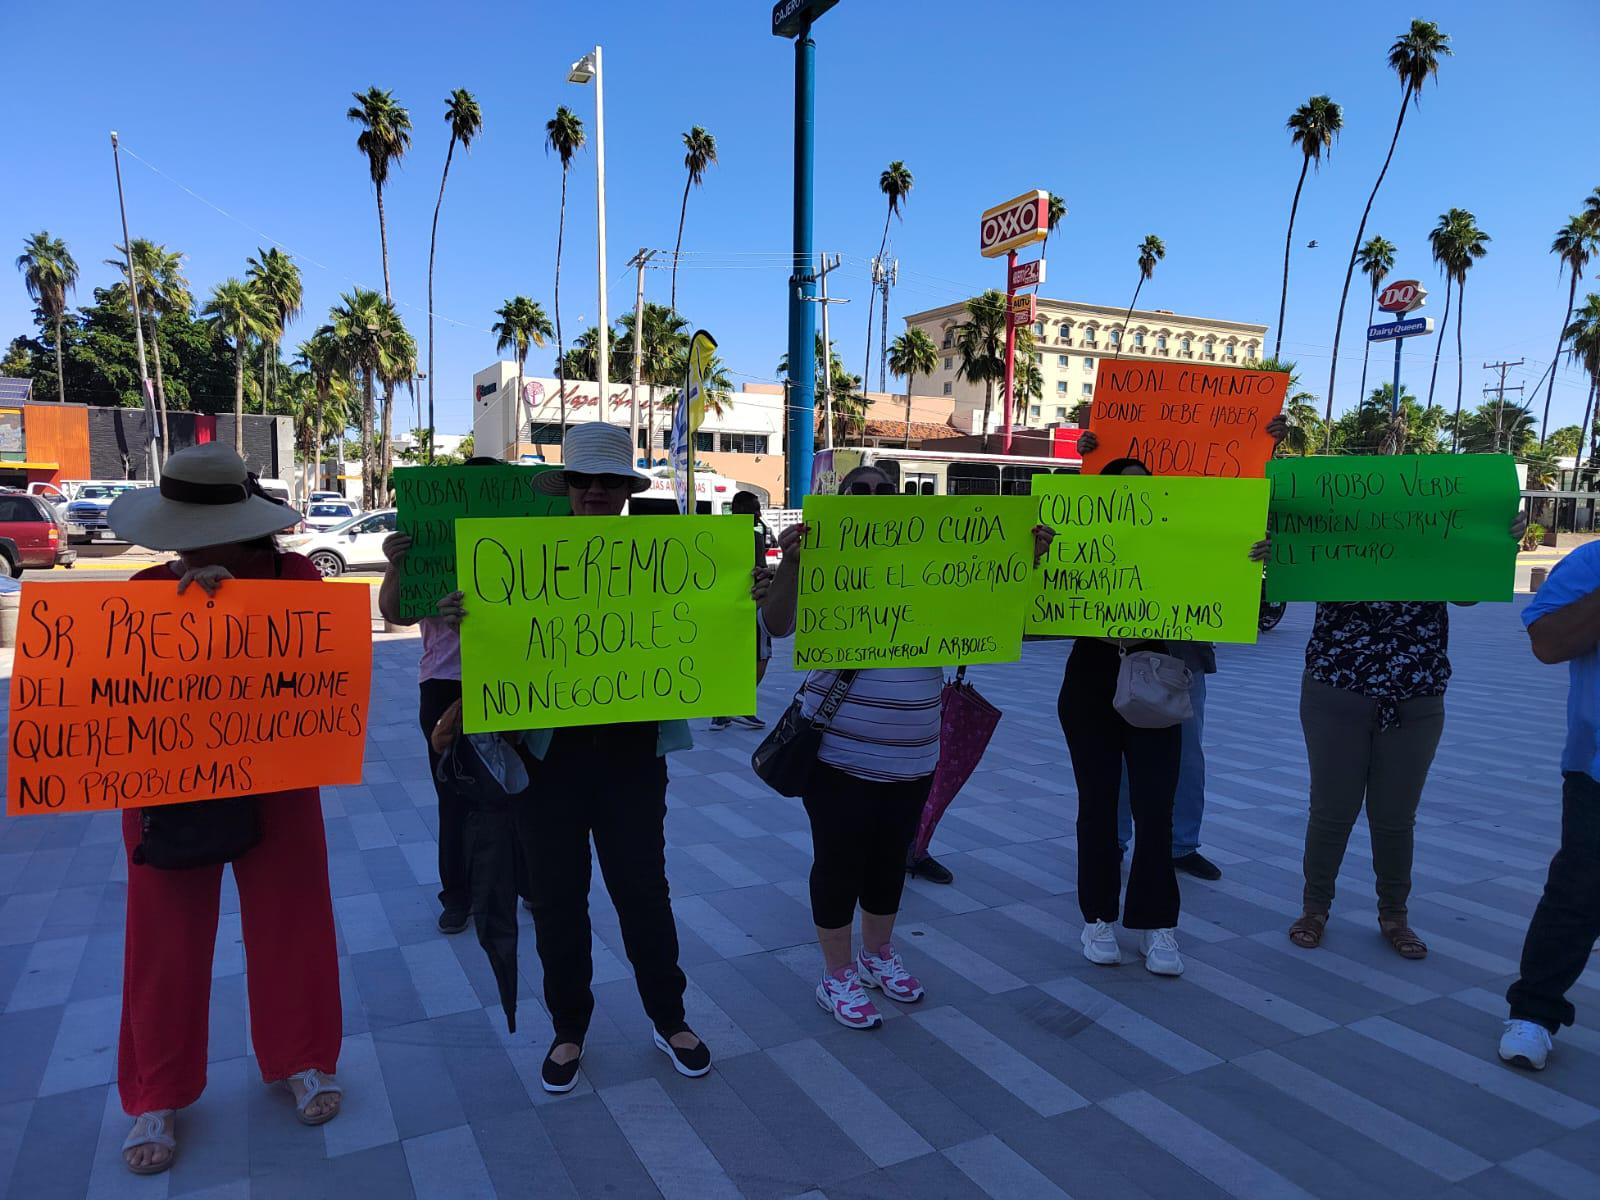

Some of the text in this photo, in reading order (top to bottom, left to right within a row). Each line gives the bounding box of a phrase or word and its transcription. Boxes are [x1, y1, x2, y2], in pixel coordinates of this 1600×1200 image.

[983, 203, 1036, 245] OXXO
[1384, 286, 1414, 305] DQ
[1369, 327, 1393, 337] Dairy
[1178, 369, 1275, 397] CEMENTO
[1094, 401, 1259, 439] DONDE DEBE HABER
[1126, 436, 1241, 478] ARBOLES
[1316, 472, 1385, 505] ROBO
[1399, 460, 1468, 498] VERDE
[803, 520, 829, 549] EL
[840, 516, 925, 551] PUEBLO
[1366, 510, 1466, 540] DESTRUYE
[473, 532, 717, 608] QUEREMOS
[800, 566, 825, 595] LO
[834, 565, 876, 592] QUE
[886, 564, 914, 588] EL
[1043, 565, 1143, 596] MARGARITA
[526, 601, 698, 668] ARBOLES
[1185, 601, 1223, 629] MAS
[14, 671, 350, 711] DEL MUNICIPIO DE AHOME
[528, 656, 702, 713] NEGOCIOS
[13, 703, 363, 768] QUEREMOS SOLUCIONES
[19, 756, 254, 808] NO PROBLEMAS
